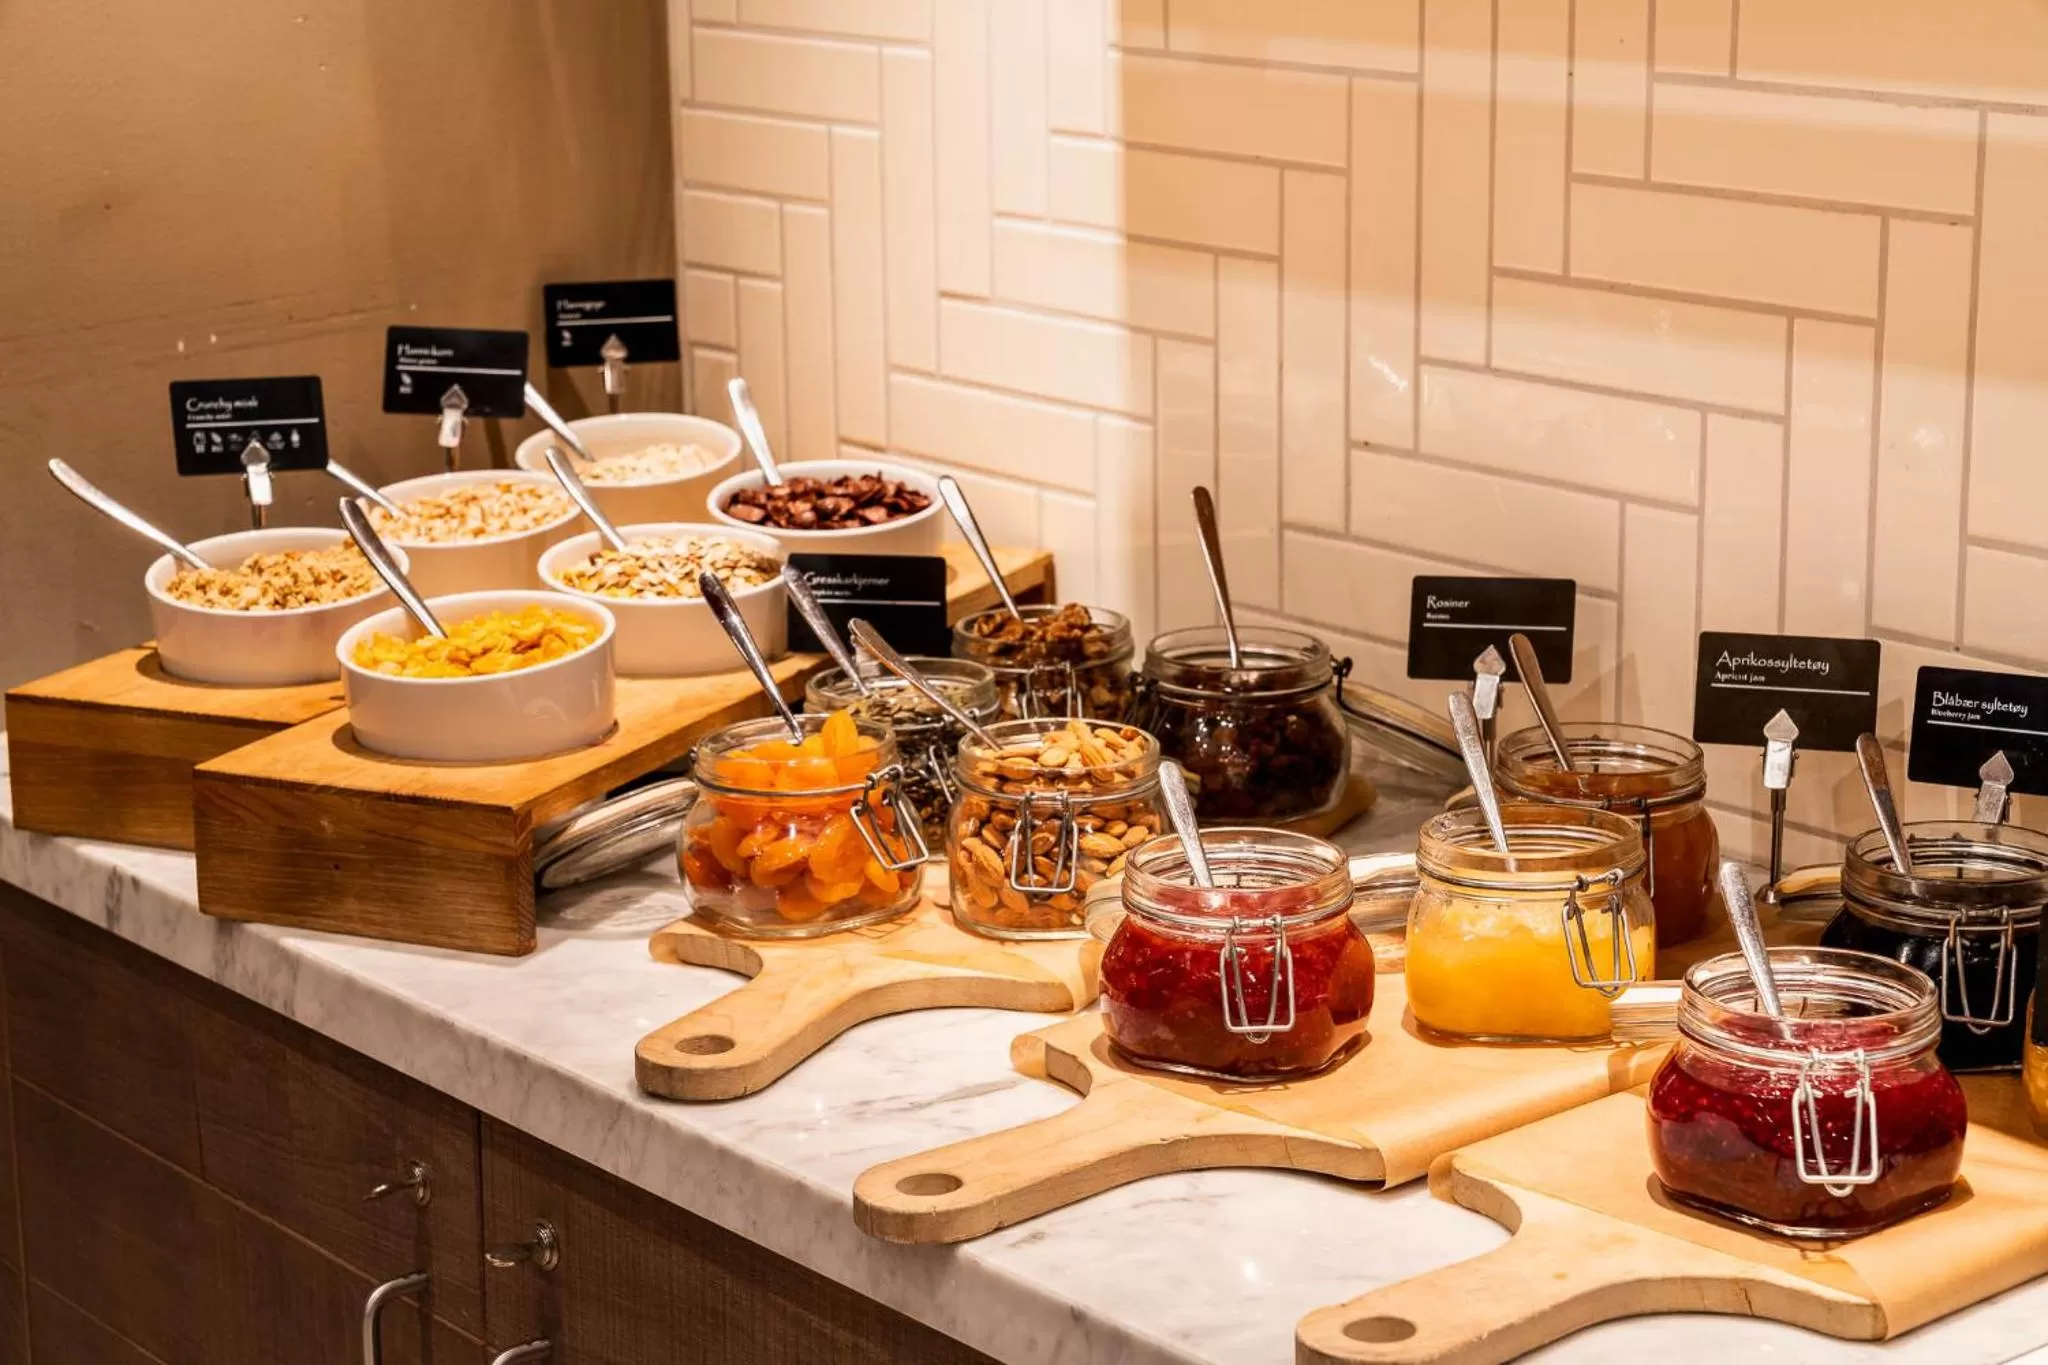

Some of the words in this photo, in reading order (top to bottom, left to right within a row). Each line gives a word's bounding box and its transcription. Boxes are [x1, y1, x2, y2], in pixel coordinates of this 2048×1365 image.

[1426, 595, 1470, 610] Rosiner
[1715, 649, 1830, 676] Aprikossyltetøy
[1749, 673, 1766, 684] jam
[1932, 690, 1979, 708] Blåbær
[1981, 697, 2029, 719] syltetøy
